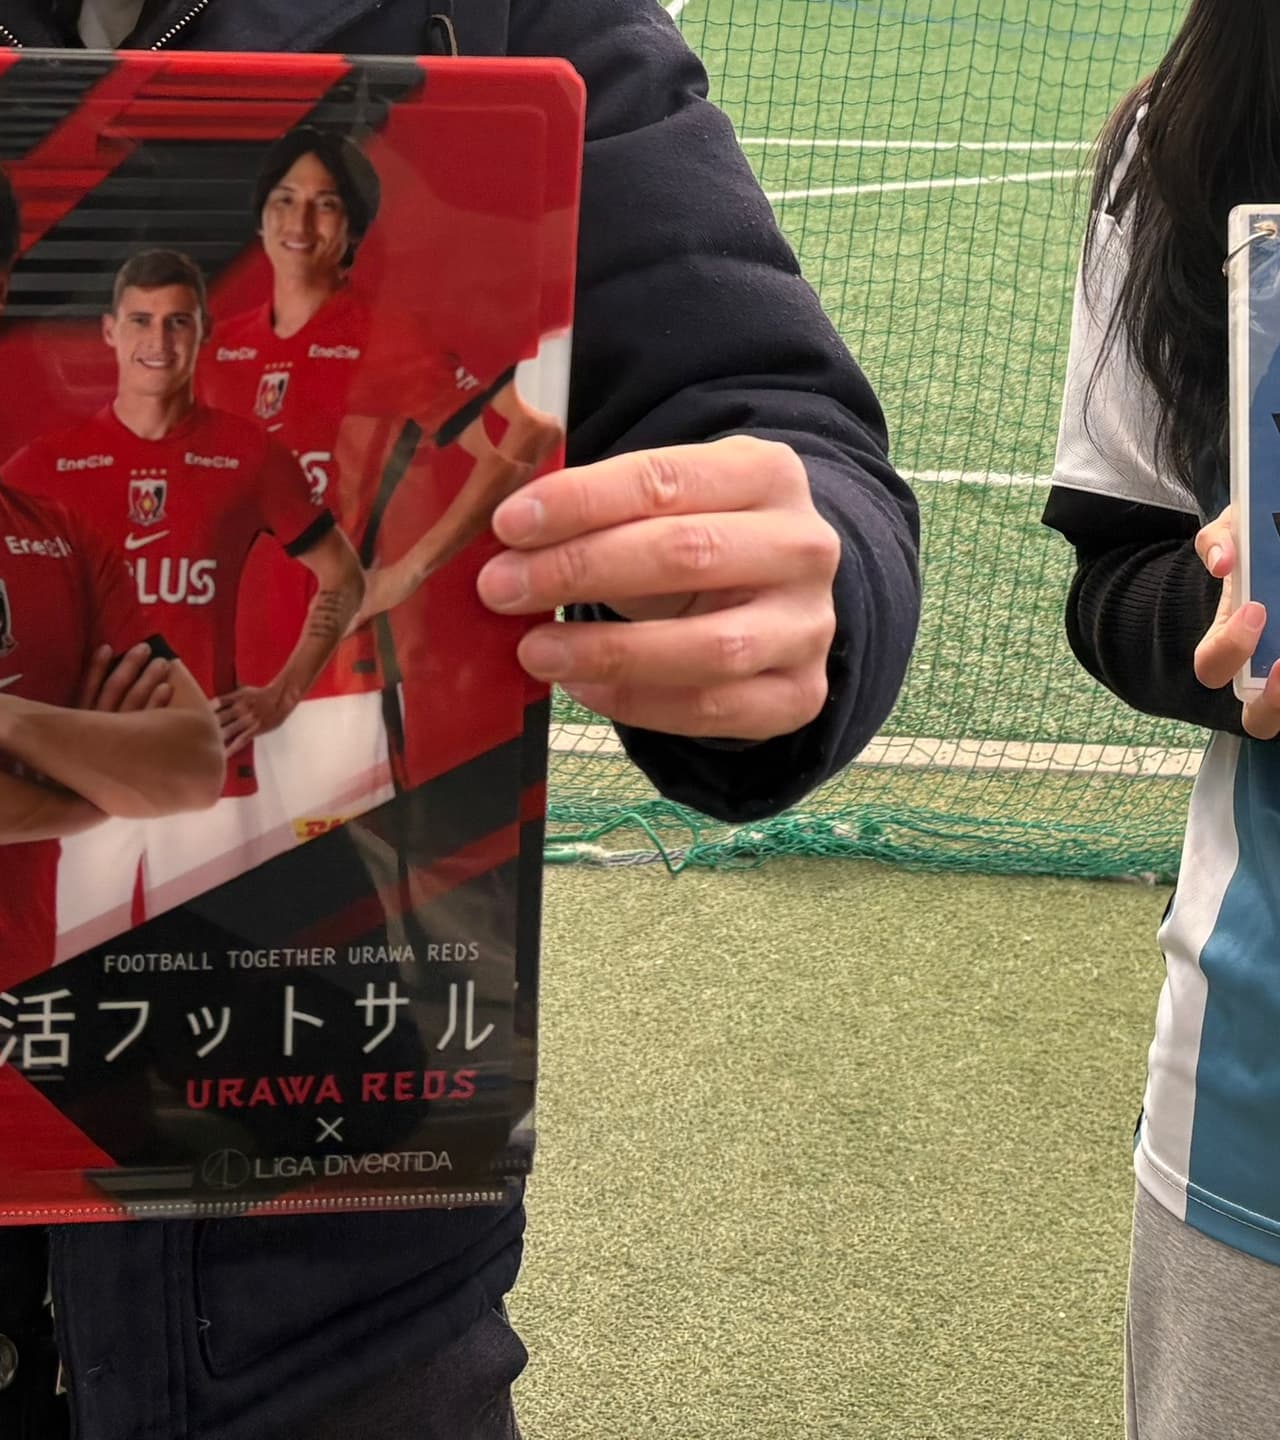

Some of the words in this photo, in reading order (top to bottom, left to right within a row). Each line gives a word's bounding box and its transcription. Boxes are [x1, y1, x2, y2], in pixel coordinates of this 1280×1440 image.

[124, 557, 218, 605] LUS
[104, 950, 213, 974] FOOTBALL
[227, 947, 337, 970] TOGETHER
[347, 944, 416, 966] URAWA
[427, 941, 480, 962] REDS
[185, 1074, 344, 1109] URAWA
[361, 1069, 480, 1102] REDS
